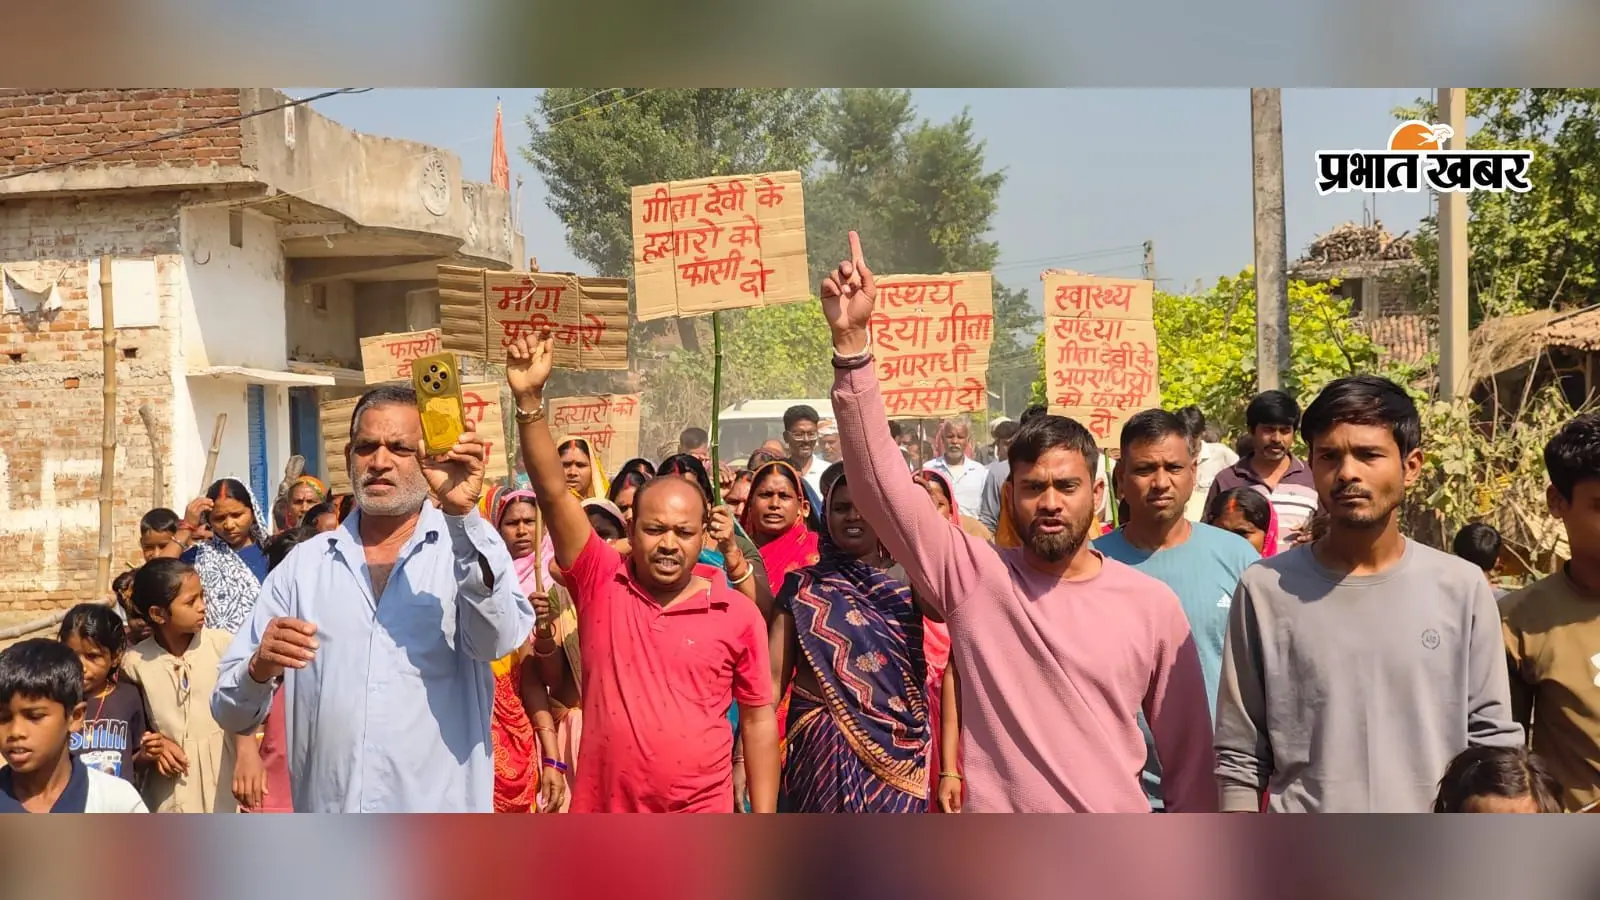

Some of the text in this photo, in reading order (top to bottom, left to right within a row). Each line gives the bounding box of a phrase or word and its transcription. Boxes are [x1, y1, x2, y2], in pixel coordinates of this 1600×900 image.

[643, 177, 785, 223] गीता देवी के
[729, 215, 763, 248] को
[740, 259, 775, 298] दो
[1055, 285, 1137, 312] स्वास्थ्य
[867, 302, 993, 351] हिया गीता
[879, 343, 976, 381] अपराधी
[1058, 340, 1154, 370] गीता देवी के
[613, 396, 637, 416] को
[956, 377, 985, 411] दो
[1056, 386, 1084, 408] को
[1089, 408, 1119, 438] दो
